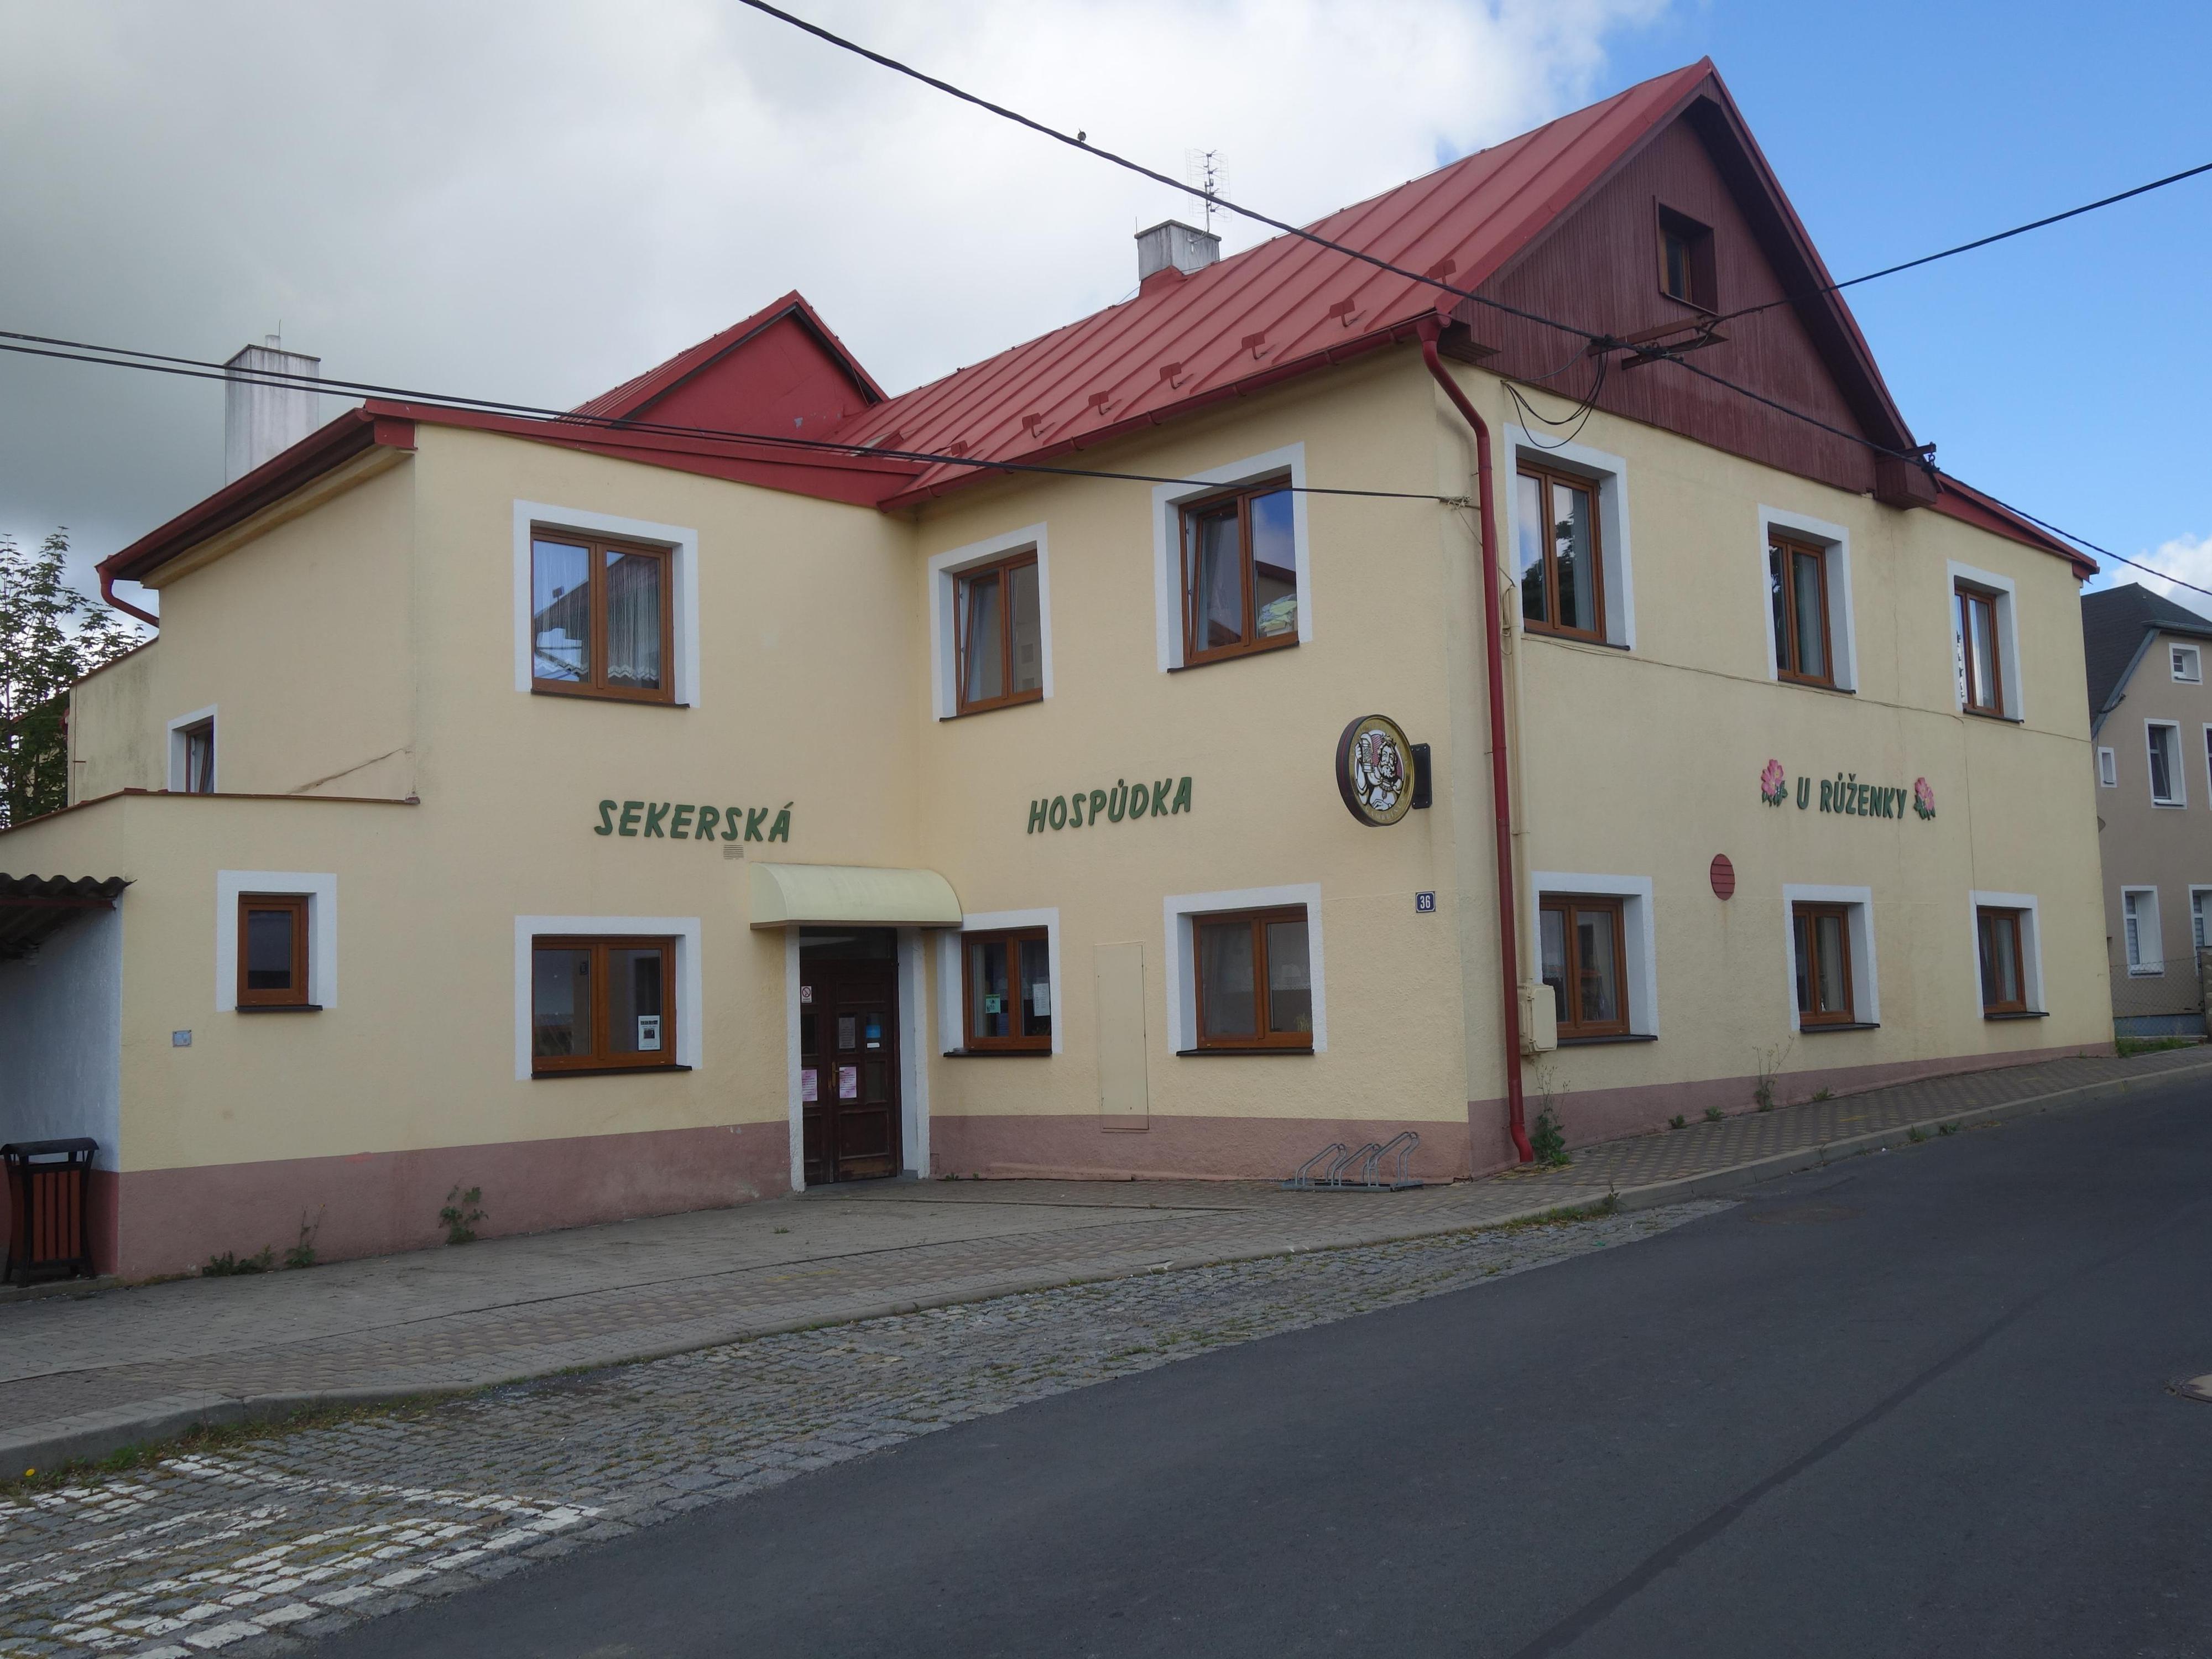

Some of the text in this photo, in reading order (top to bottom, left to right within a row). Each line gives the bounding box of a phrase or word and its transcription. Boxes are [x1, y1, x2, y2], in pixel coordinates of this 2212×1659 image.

[1027, 776, 1192, 834] HOSPŮDKA
[1796, 772, 1908, 818] U RŮŽENKY
[594, 800, 794, 843] SEKERSKÁ
[1420, 895, 1431, 909] 36
